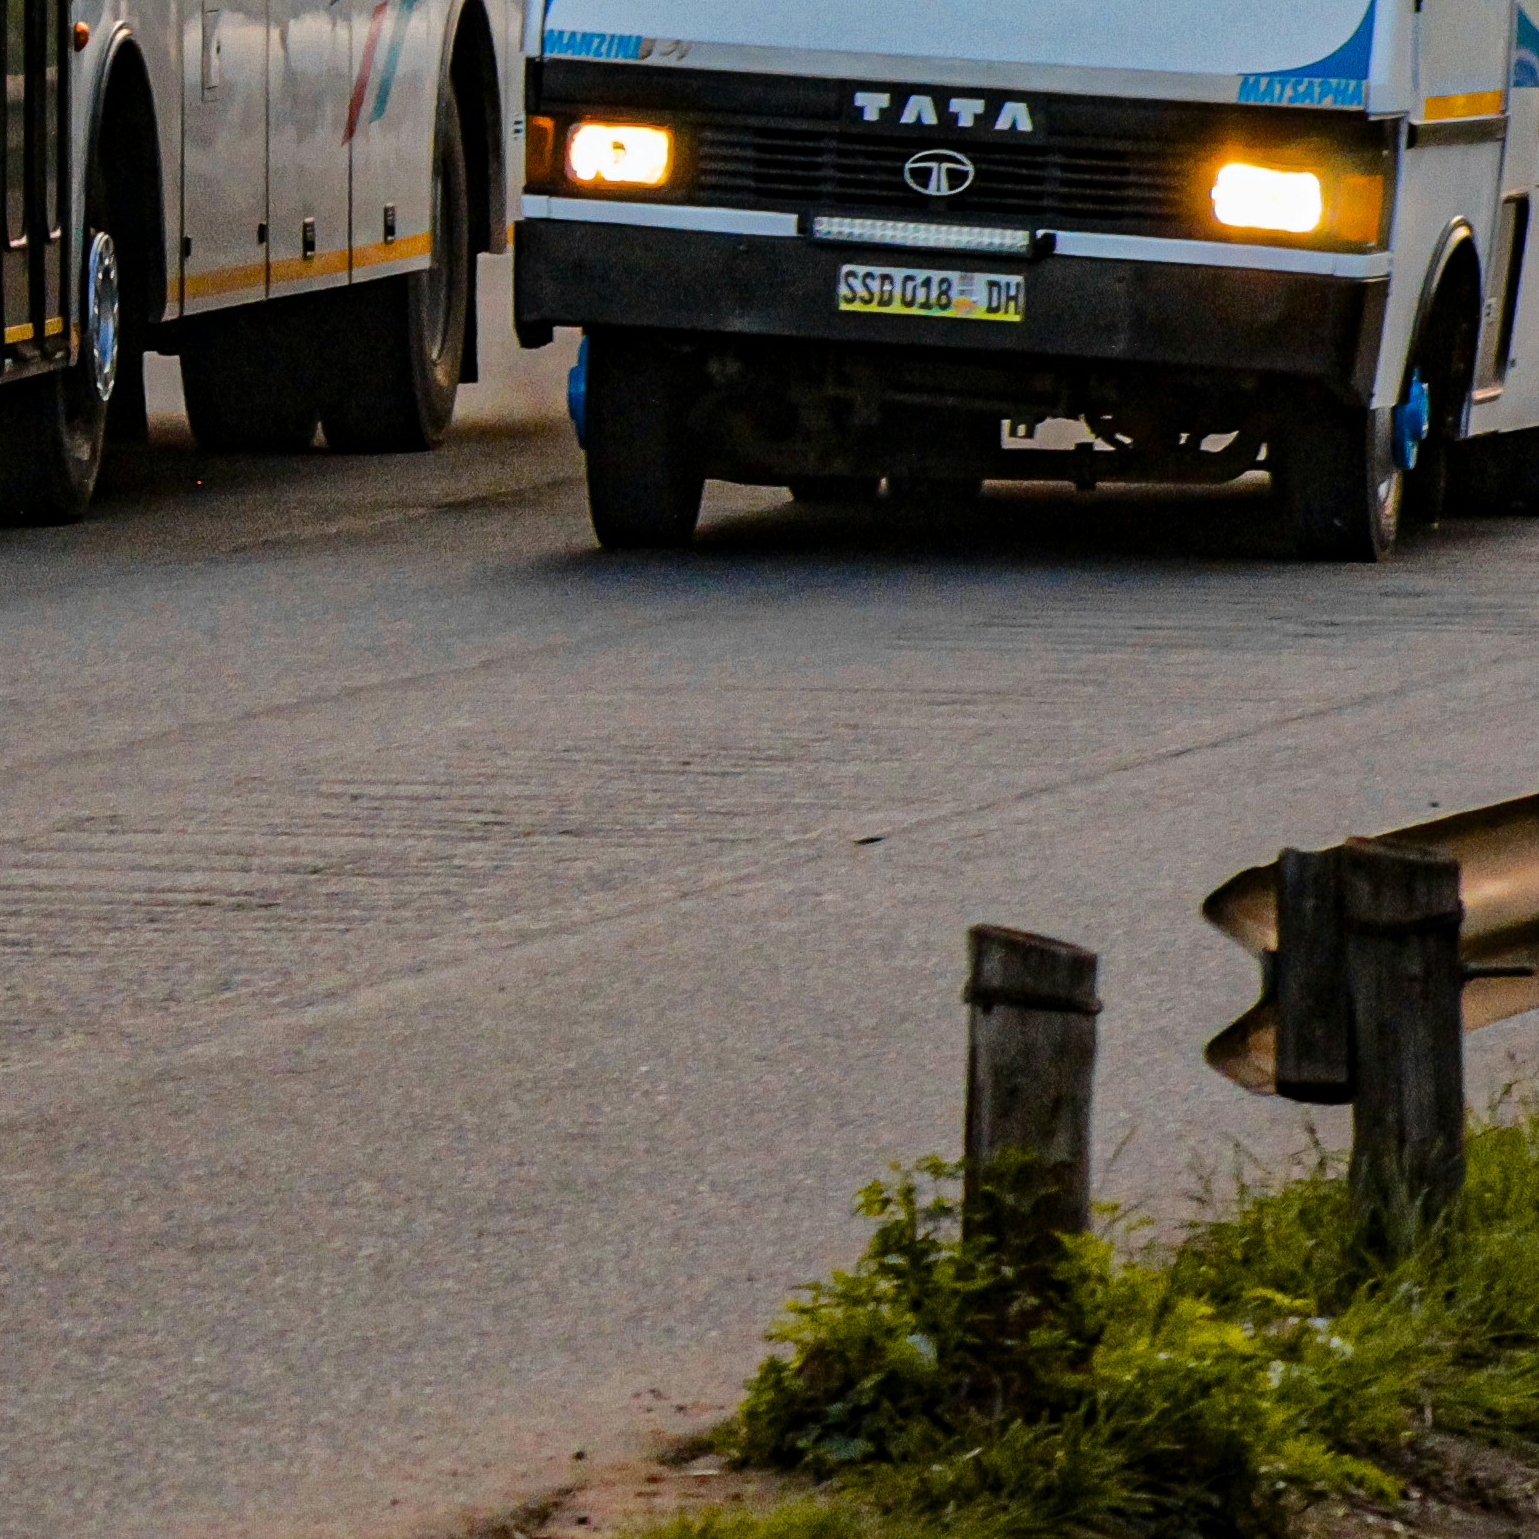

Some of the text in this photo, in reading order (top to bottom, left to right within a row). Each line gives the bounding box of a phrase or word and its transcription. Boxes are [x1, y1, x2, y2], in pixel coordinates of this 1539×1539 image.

[1237, 76, 1364, 106] MATSAPHA
[854, 91, 1033, 132] TATA
[985, 279, 1022, 316] DH
